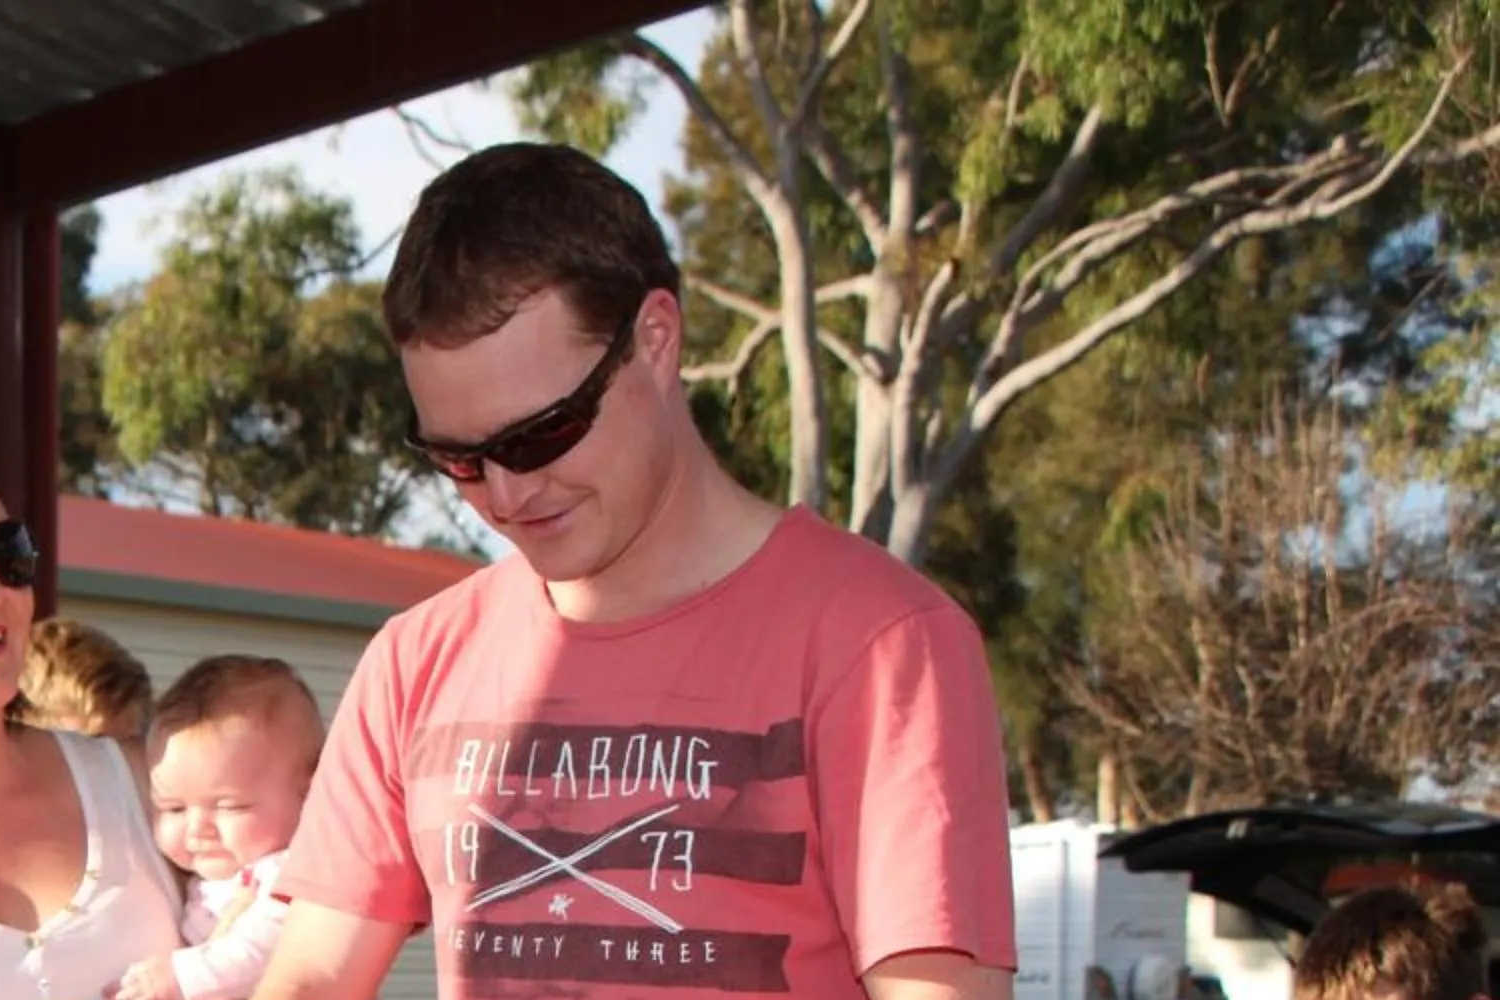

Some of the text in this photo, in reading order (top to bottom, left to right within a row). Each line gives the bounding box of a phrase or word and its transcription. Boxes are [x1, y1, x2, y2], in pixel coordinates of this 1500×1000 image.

[456, 735, 718, 799] BILLABONG
[443, 822, 696, 892] 19 73
[600, 940, 717, 964] THREE
